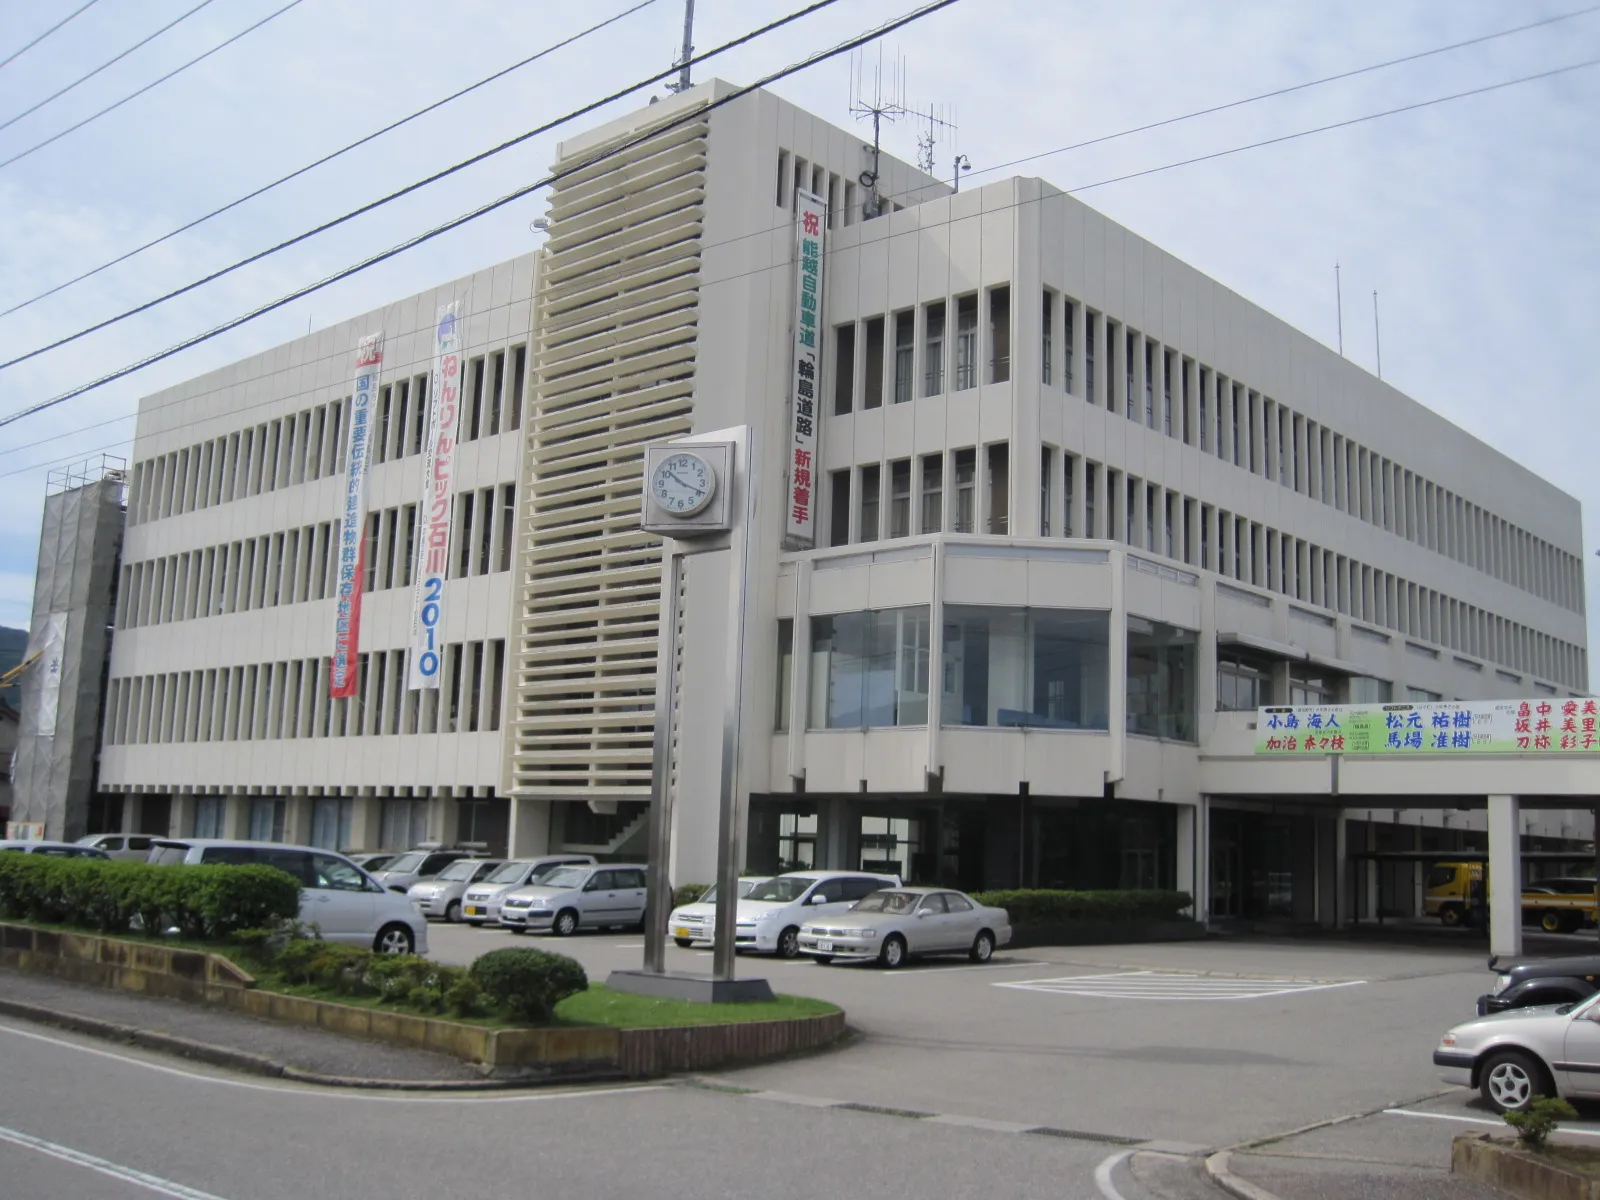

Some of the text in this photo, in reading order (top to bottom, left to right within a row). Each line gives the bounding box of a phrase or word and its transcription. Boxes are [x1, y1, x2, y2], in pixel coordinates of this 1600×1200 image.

[803, 211, 819, 237] 祝
[357, 338, 378, 362] 祝
[1518, 701, 1551, 717] 畠中
[1561, 700, 1597, 716] 愛美
[1267, 714, 1299, 730] 小島
[1307, 713, 1340, 729] 海人
[1385, 711, 1423, 729] 松元
[1432, 711, 1471, 728] 祐樹
[1514, 718, 1597, 733] 坂井 美里
[1266, 736, 1297, 750] 加治
[1304, 735, 1345, 751] 奈々枝
[1384, 731, 1422, 749] 馬場
[1431, 731, 1471, 748] 准樹
[1560, 734, 1597, 749] 彩子
